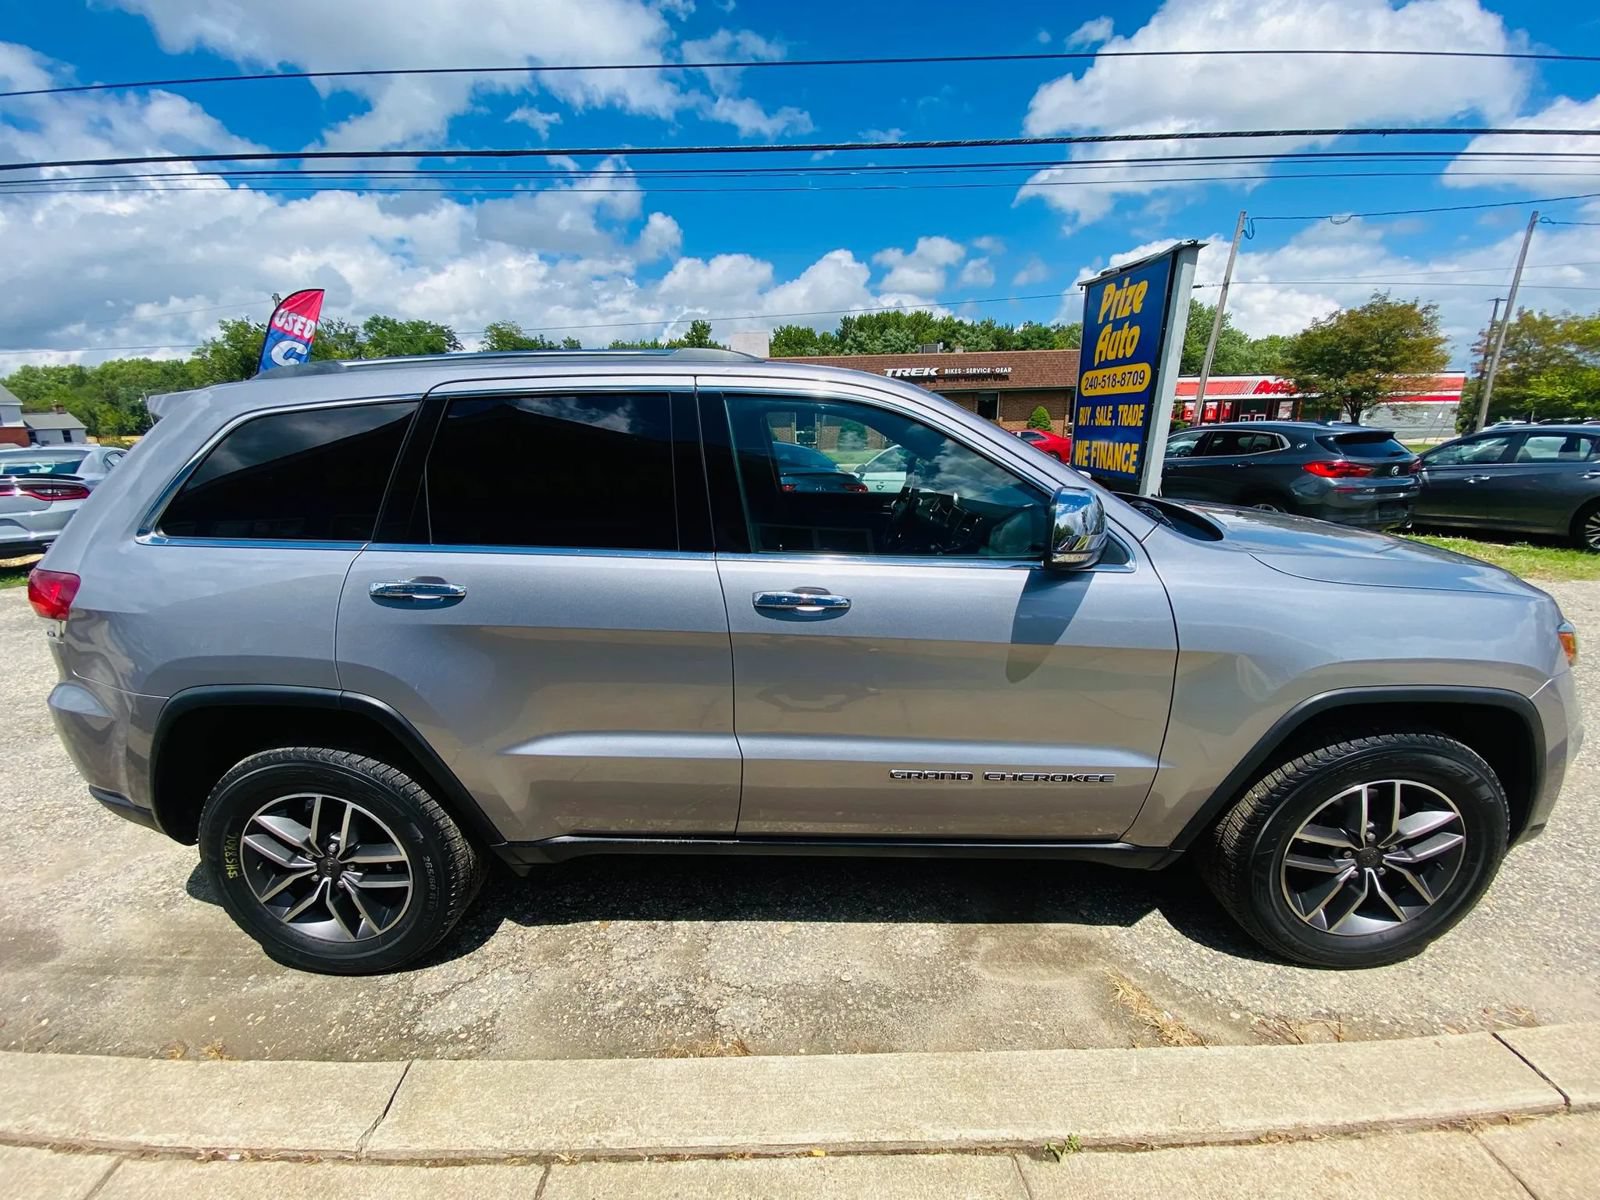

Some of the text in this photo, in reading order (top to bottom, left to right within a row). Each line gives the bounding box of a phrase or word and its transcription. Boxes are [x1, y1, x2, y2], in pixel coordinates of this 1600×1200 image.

[1098, 277, 1148, 324] Prize
[274, 308, 316, 339] USED
[1094, 321, 1140, 367] Auto
[883, 367, 940, 377] TREK
[1084, 369, 1146, 391] 240-518-8709
[1078, 406, 1092, 426] BUY
[1117, 404, 1145, 427] TRADE
[1075, 440, 1139, 474] WE FINANCE
[888, 769, 1117, 783] GRAND CHEROKEE
